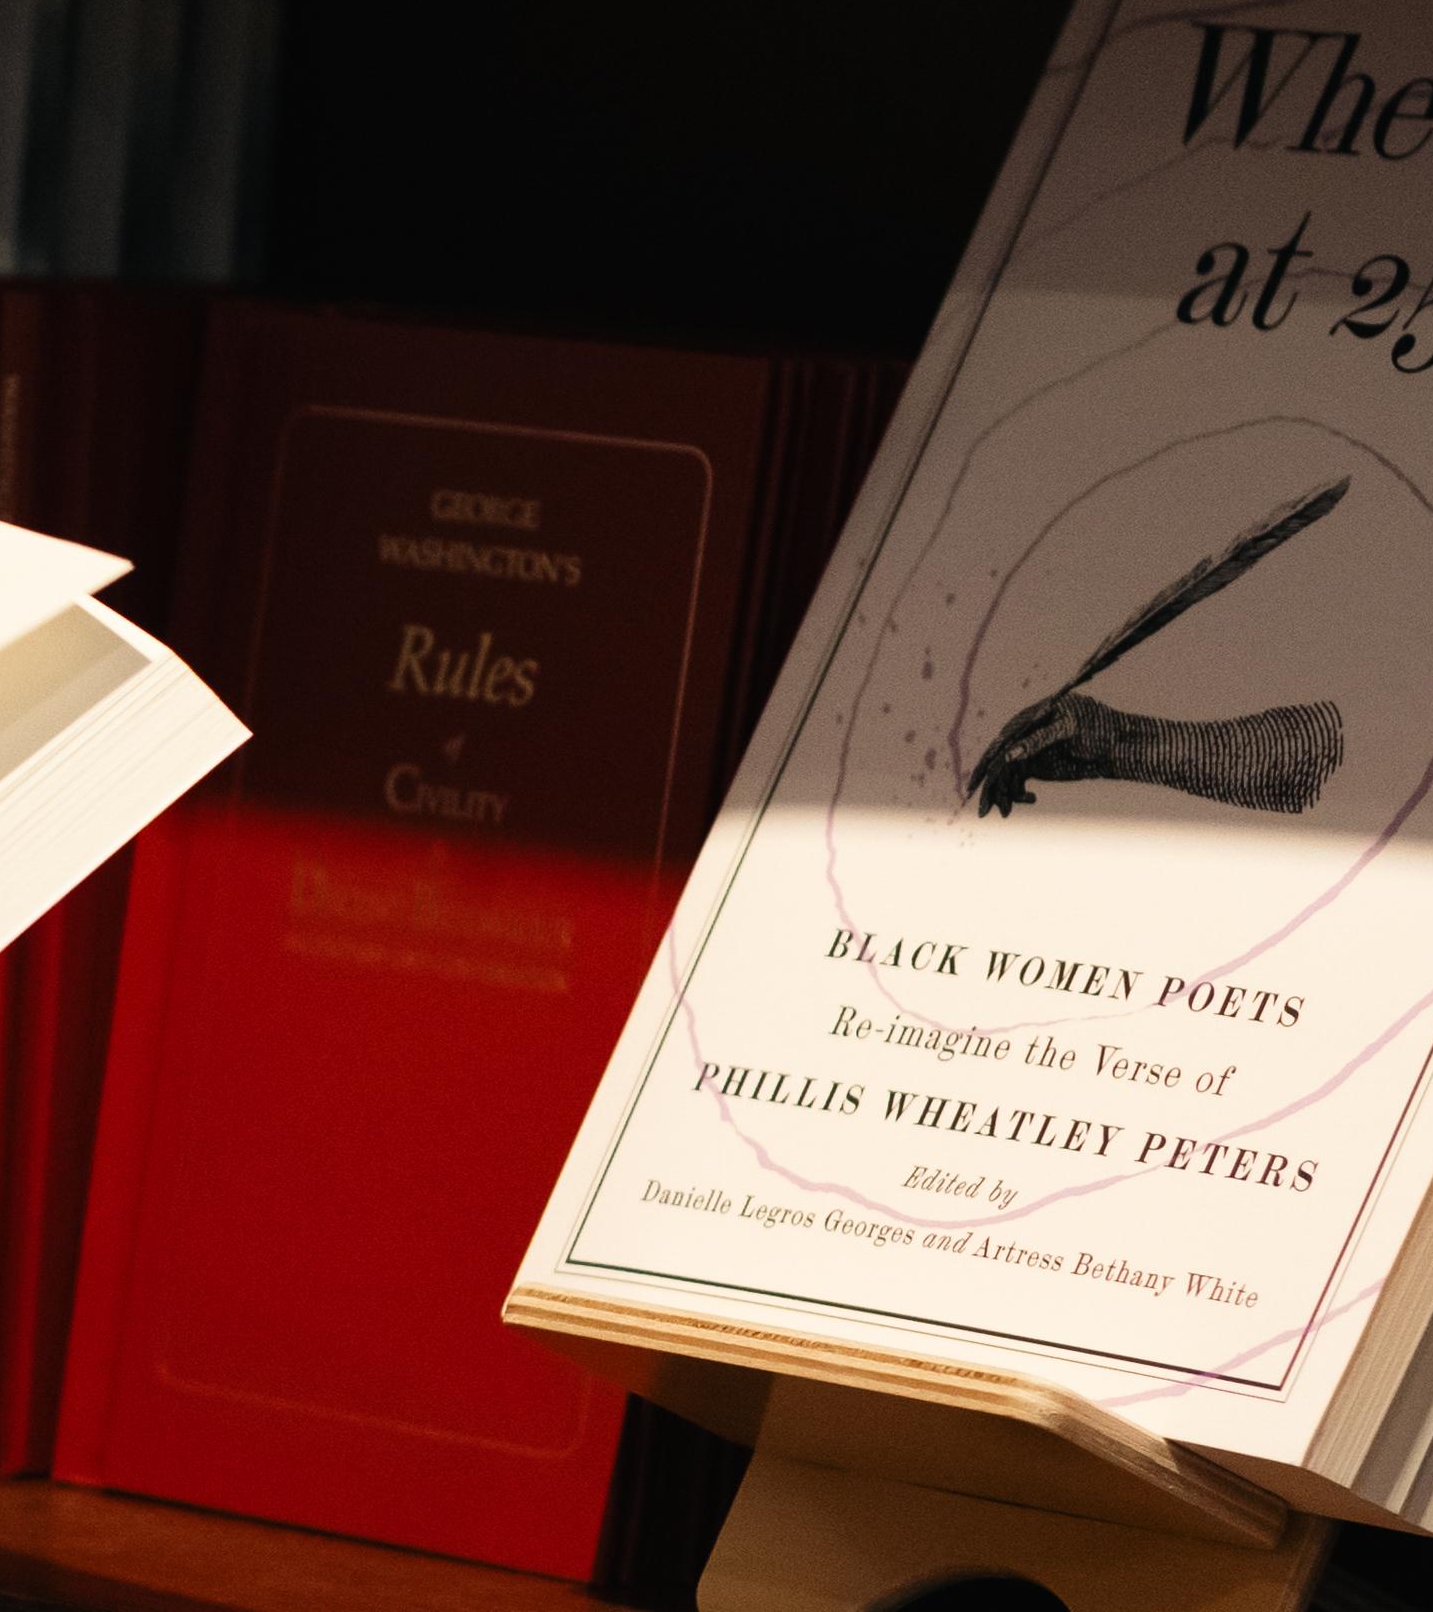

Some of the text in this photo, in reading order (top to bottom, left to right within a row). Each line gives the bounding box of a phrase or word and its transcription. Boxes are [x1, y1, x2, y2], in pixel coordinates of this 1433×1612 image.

[1176, 213, 1312, 332] at
[429, 488, 542, 532] GEORGE
[386, 622, 540, 709] Rules
[827, 929, 1305, 1025] BLACK WOMEN POETS
[828, 1006, 1237, 1096] Re-imagine the Verse of
[692, 1062, 1318, 1189] PHILLIS WHEATLEY PETERS
[902, 1165, 1018, 1210] Edited by
[642, 1180, 1258, 1308] Danielle Legros Georges and Artress Bethany White
